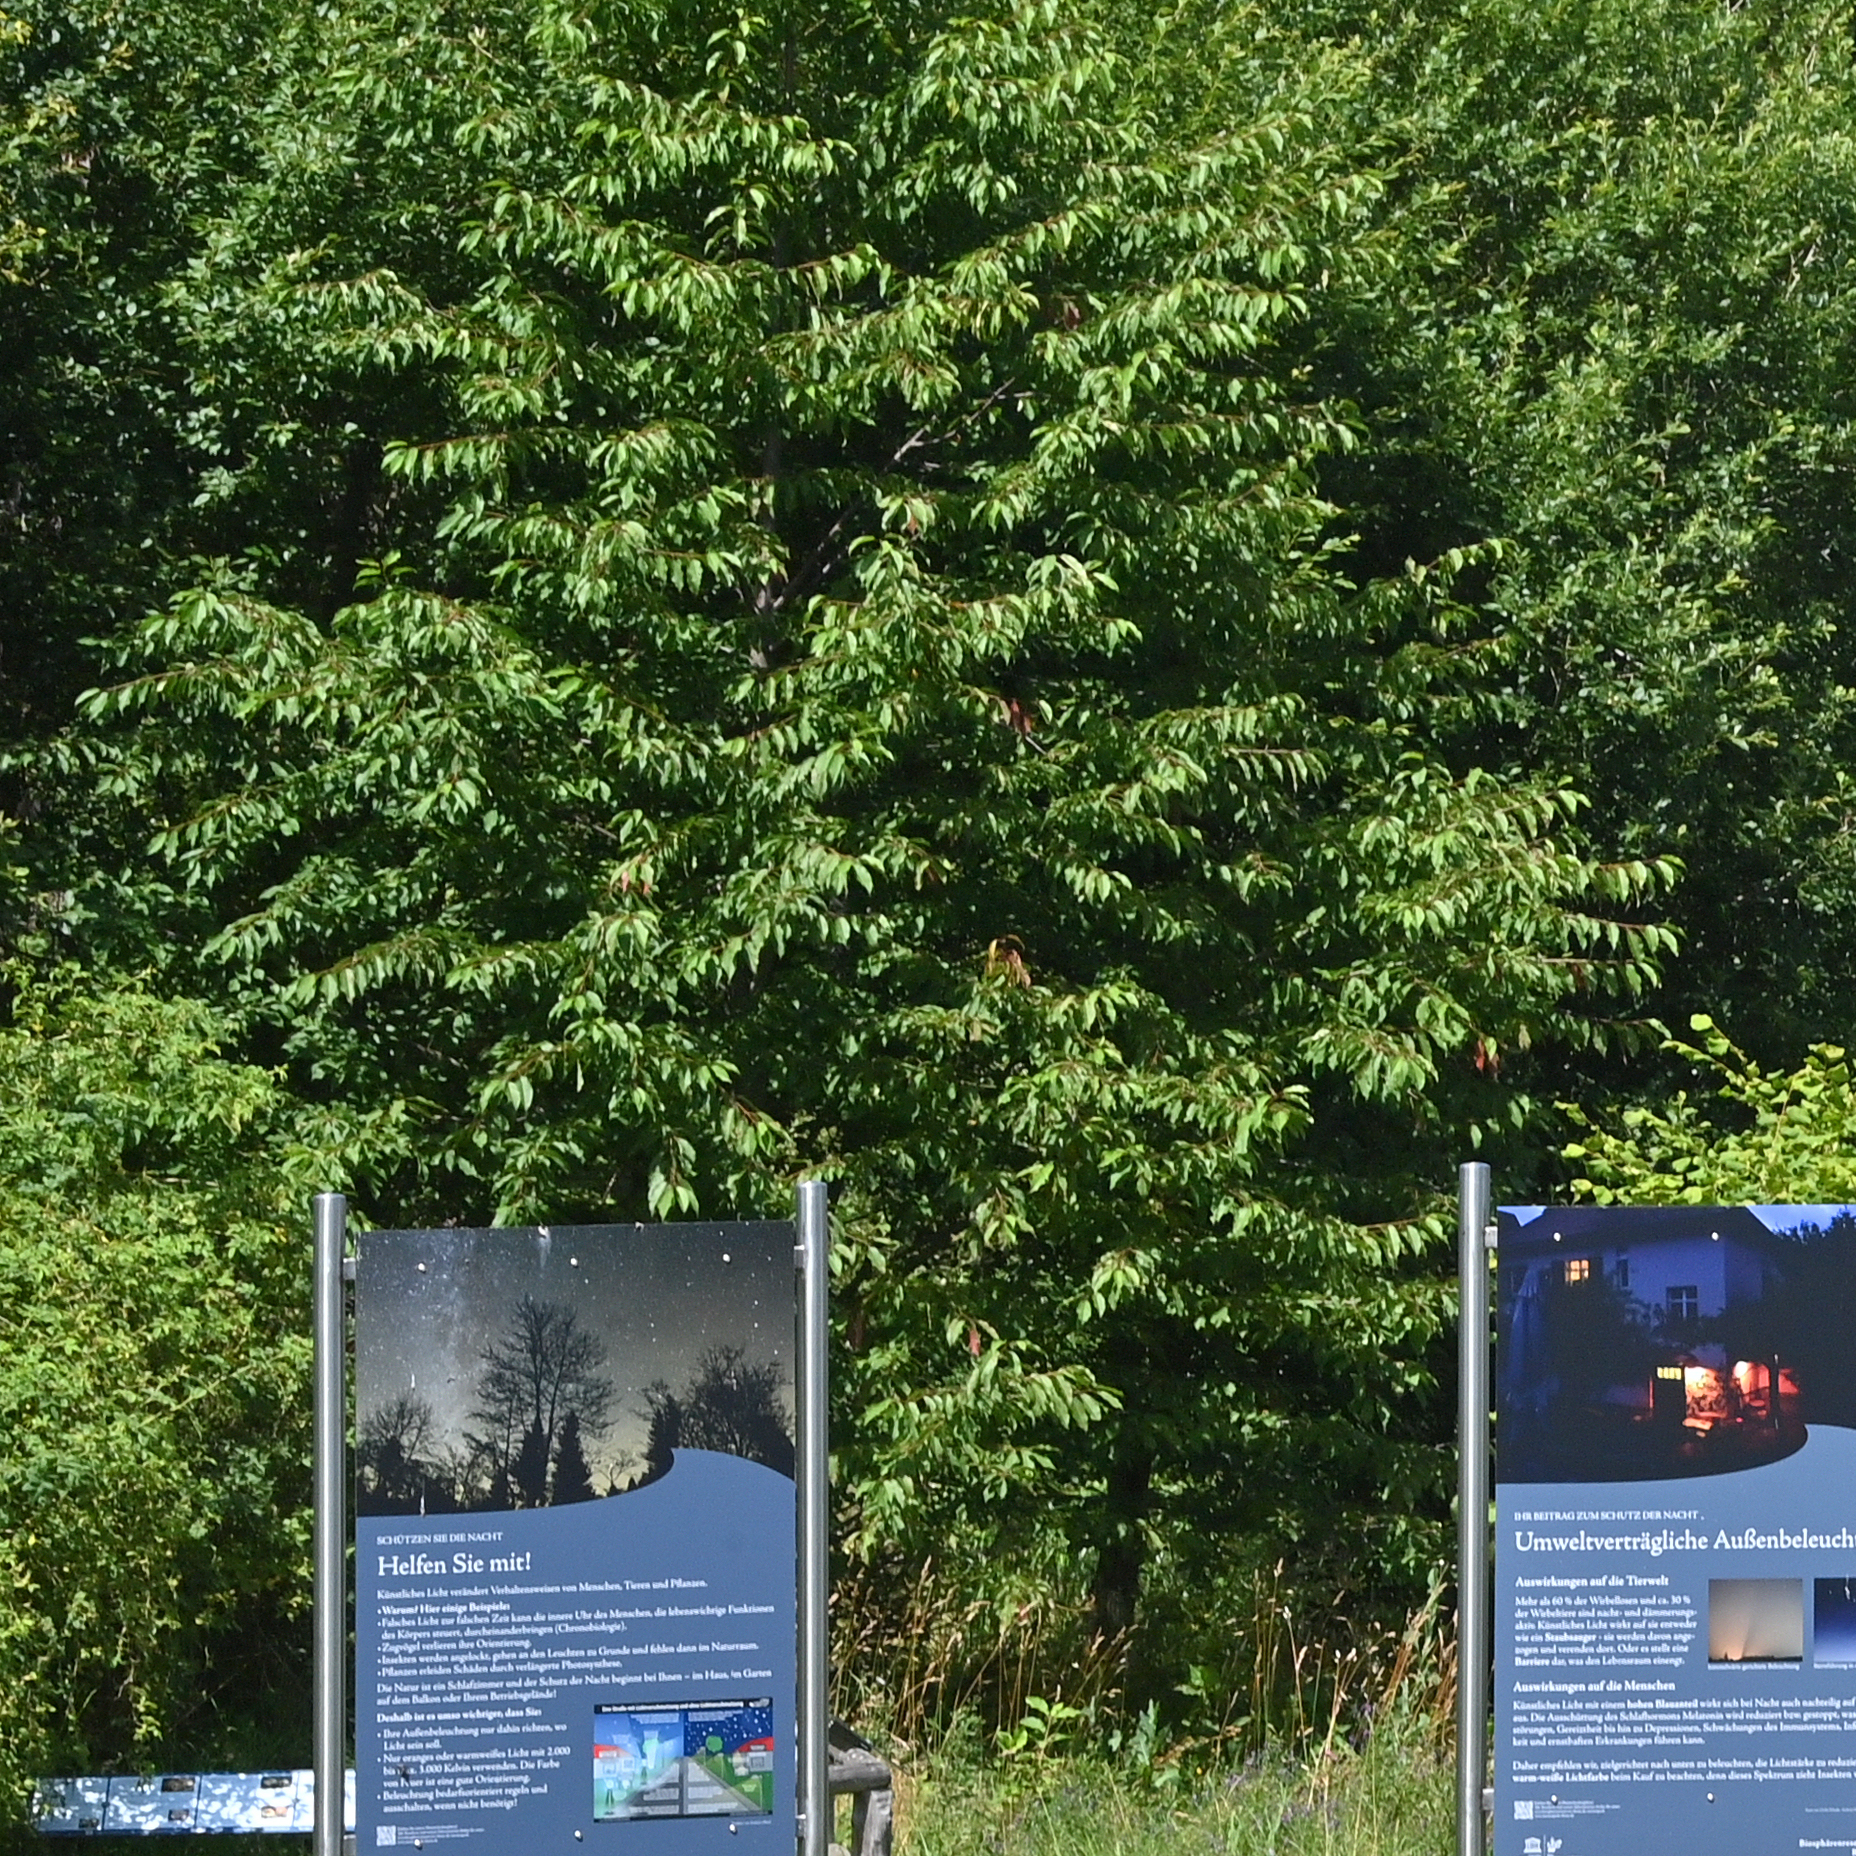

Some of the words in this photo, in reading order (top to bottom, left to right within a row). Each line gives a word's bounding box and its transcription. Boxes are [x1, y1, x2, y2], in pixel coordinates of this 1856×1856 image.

[1513, 1511, 1533, 1521] IHR
[1533, 1511, 1576, 1521] BEITRAG
[1576, 1510, 1600, 1521] ZUM
[1600, 1510, 1641, 1521] SCHUTZ
[1642, 1510, 1662, 1520] DER
[1663, 1510, 1698, 1520] NACHT
[376, 1533, 432, 1546] SCHÜTZEN
[432, 1533, 448, 1544] SIE
[449, 1532, 467, 1543] DIE
[467, 1531, 503, 1542] NACHT
[1515, 1528, 1709, 1558] Umweltverträgliche
[377, 1552, 447, 1577] Helfen
[452, 1552, 484, 1574] Sie
[489, 1551, 531, 1573] mit!
[376, 1587, 426, 1600] Künstliches
[426, 1587, 449, 1598] Licht
[449, 1585, 489, 1597] verändert
[490, 1582, 561, 1595] Verhaltensweisen
[561, 1584, 578, 1593] von
[578, 1580, 623, 1593] Menschen,
[623, 1579, 651, 1591] Tieren
[651, 1578, 670, 1589] und
[669, 1576, 708, 1589] Pflanzen.
[1515, 1575, 1588, 1591] Auswirkungen
[1589, 1574, 1608, 1587] auf
[1608, 1574, 1625, 1587] die
[1626, 1574, 1669, 1587] Tierwelt
[381, 1604, 419, 1616] Warum?
[419, 1603, 441, 1614] Hier
[441, 1603, 468, 1616] einige
[469, 1601, 511, 1615] Beispiele:
[1513, 1680, 1586, 1696] Auswirkungen
[1587, 1679, 1606, 1692] auf
[1605, 1679, 1623, 1692] die
[1624, 1679, 1676, 1692] Menschen
[376, 1711, 413, 1723] Deshalb
[413, 1712, 425, 1722] ist
[426, 1713, 436, 1721] es
[436, 1712, 461, 1721] umso
[462, 1708, 504, 1722] wichtiger,
[504, 1707, 524, 1718] dass
[524, 1706, 542, 1717] Sie:
